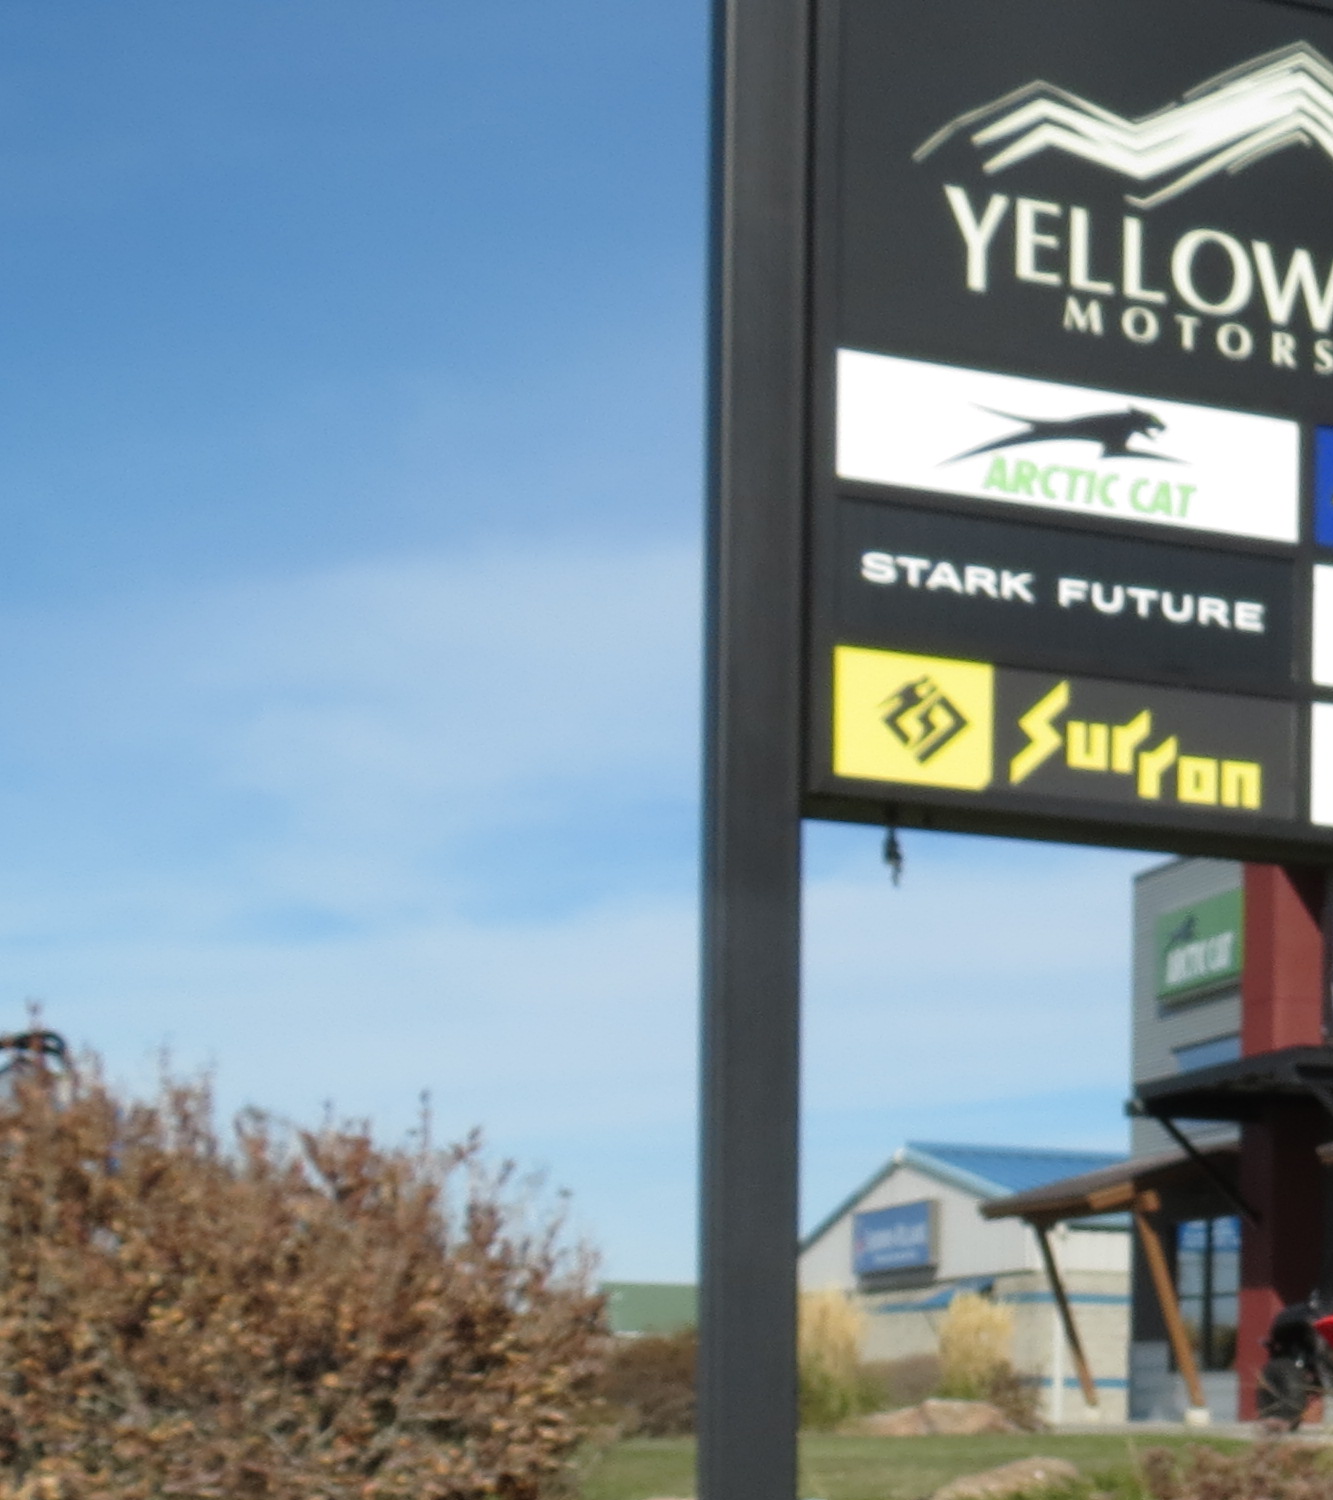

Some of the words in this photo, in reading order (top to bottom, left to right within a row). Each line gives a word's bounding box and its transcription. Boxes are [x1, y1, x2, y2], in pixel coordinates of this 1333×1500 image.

[982, 456, 1121, 507] ARCTIC
[1130, 475, 1197, 518] CAT
[860, 550, 1035, 604] STARK
[1057, 577, 1266, 634] FUTURE
